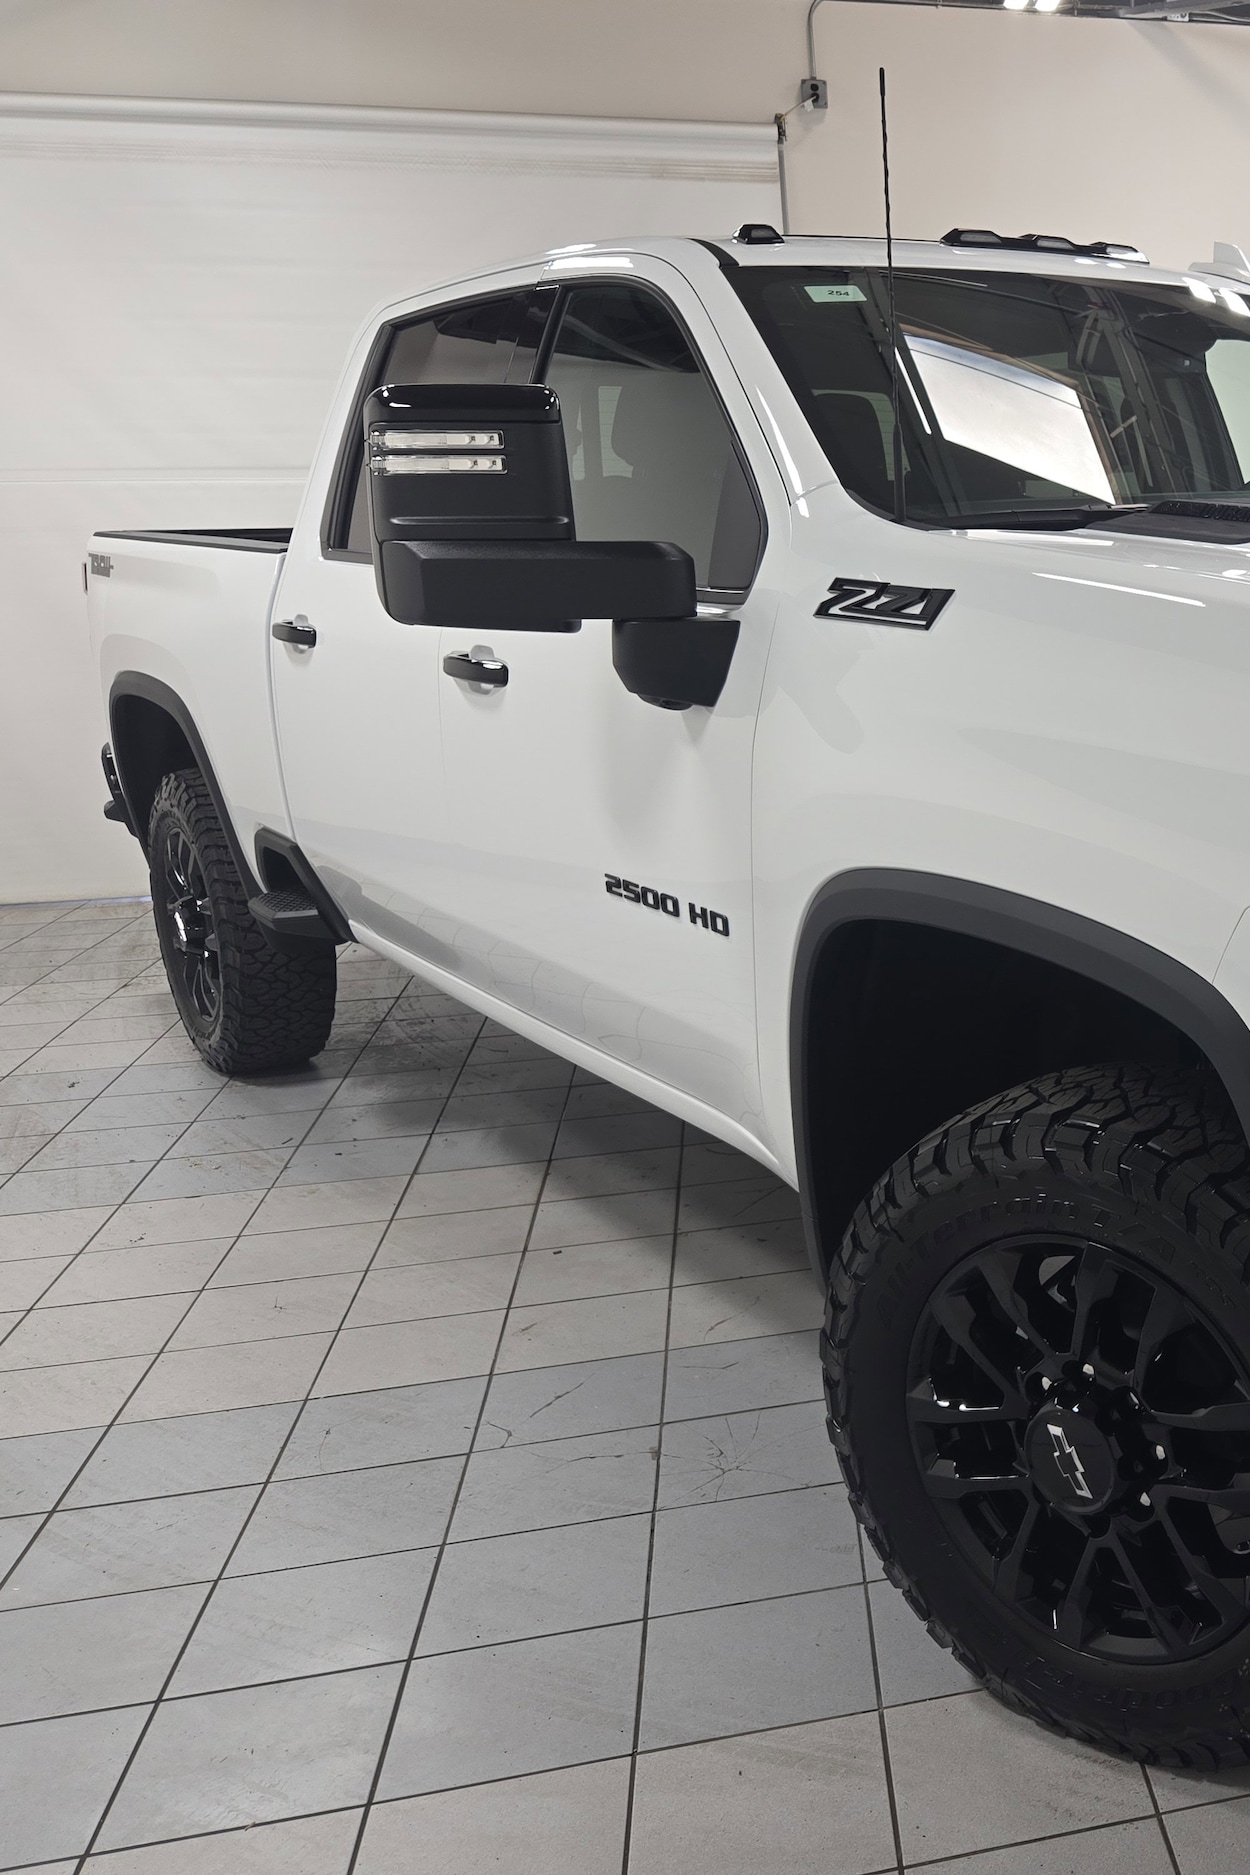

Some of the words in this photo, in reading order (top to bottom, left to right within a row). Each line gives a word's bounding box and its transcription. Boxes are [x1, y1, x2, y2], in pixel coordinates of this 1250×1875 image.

[826, 289, 850, 297] 254
[813, 577, 956, 631] Z71
[604, 872, 680, 918] 2500
[688, 901, 730, 937] HD
